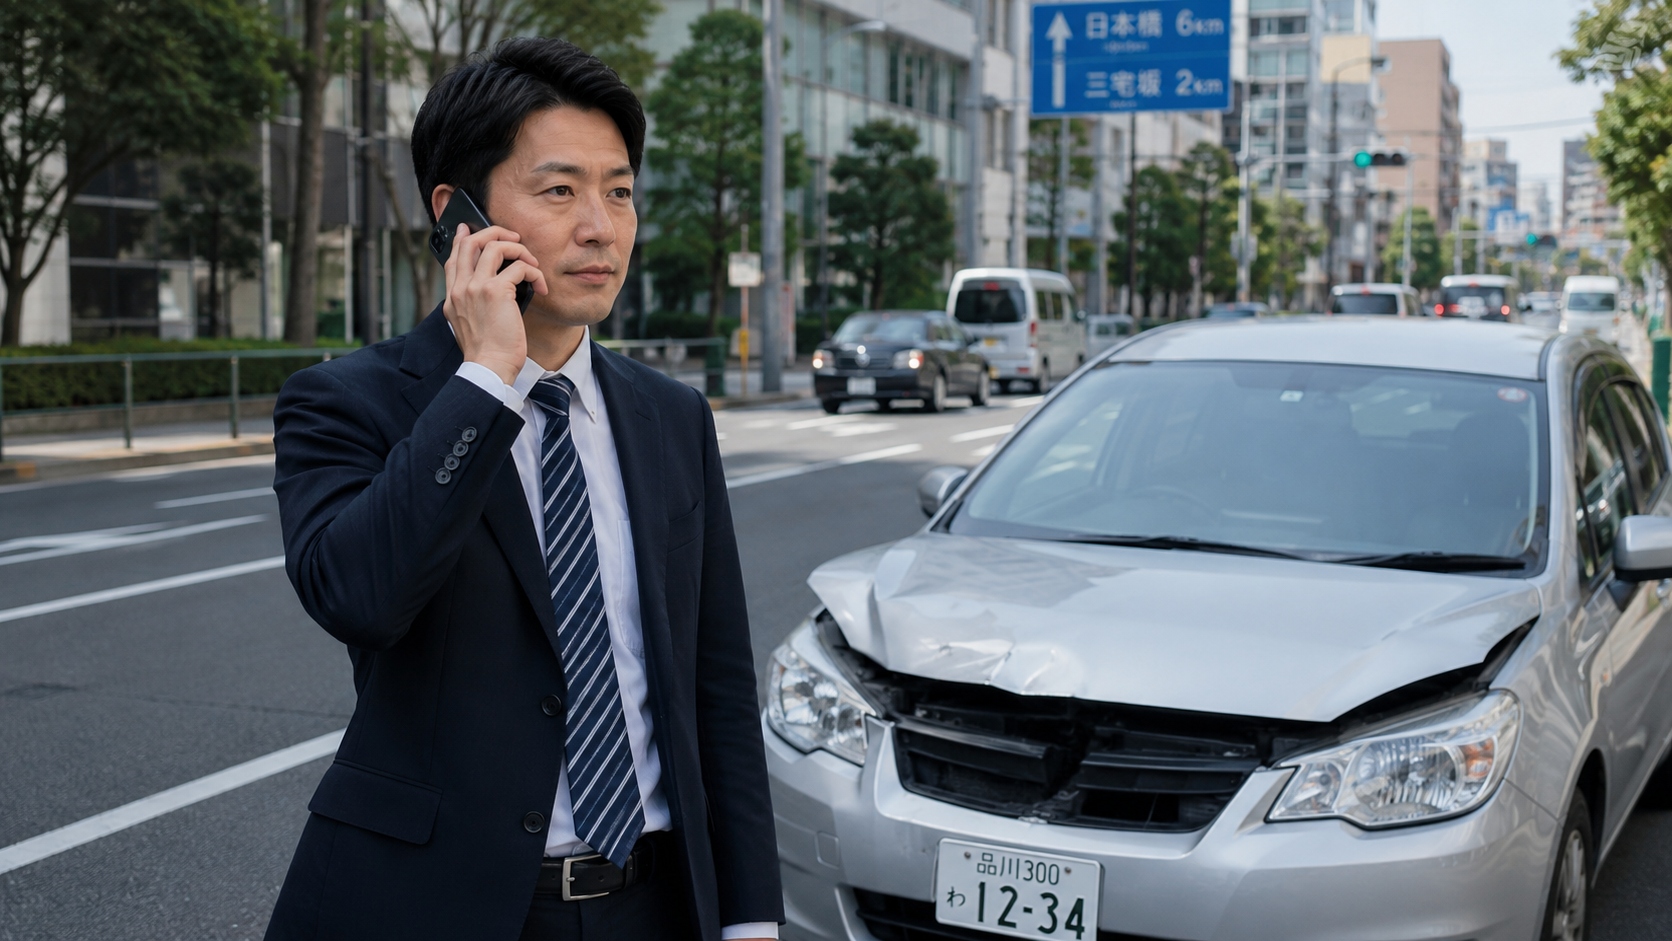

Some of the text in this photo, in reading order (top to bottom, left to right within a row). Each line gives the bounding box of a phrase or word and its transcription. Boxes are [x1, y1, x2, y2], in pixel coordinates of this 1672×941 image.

[1175, 9, 1224, 37] 6km
[1175, 69, 1223, 96] 2km
[946, 881, 1085, 940] わ 12-34
